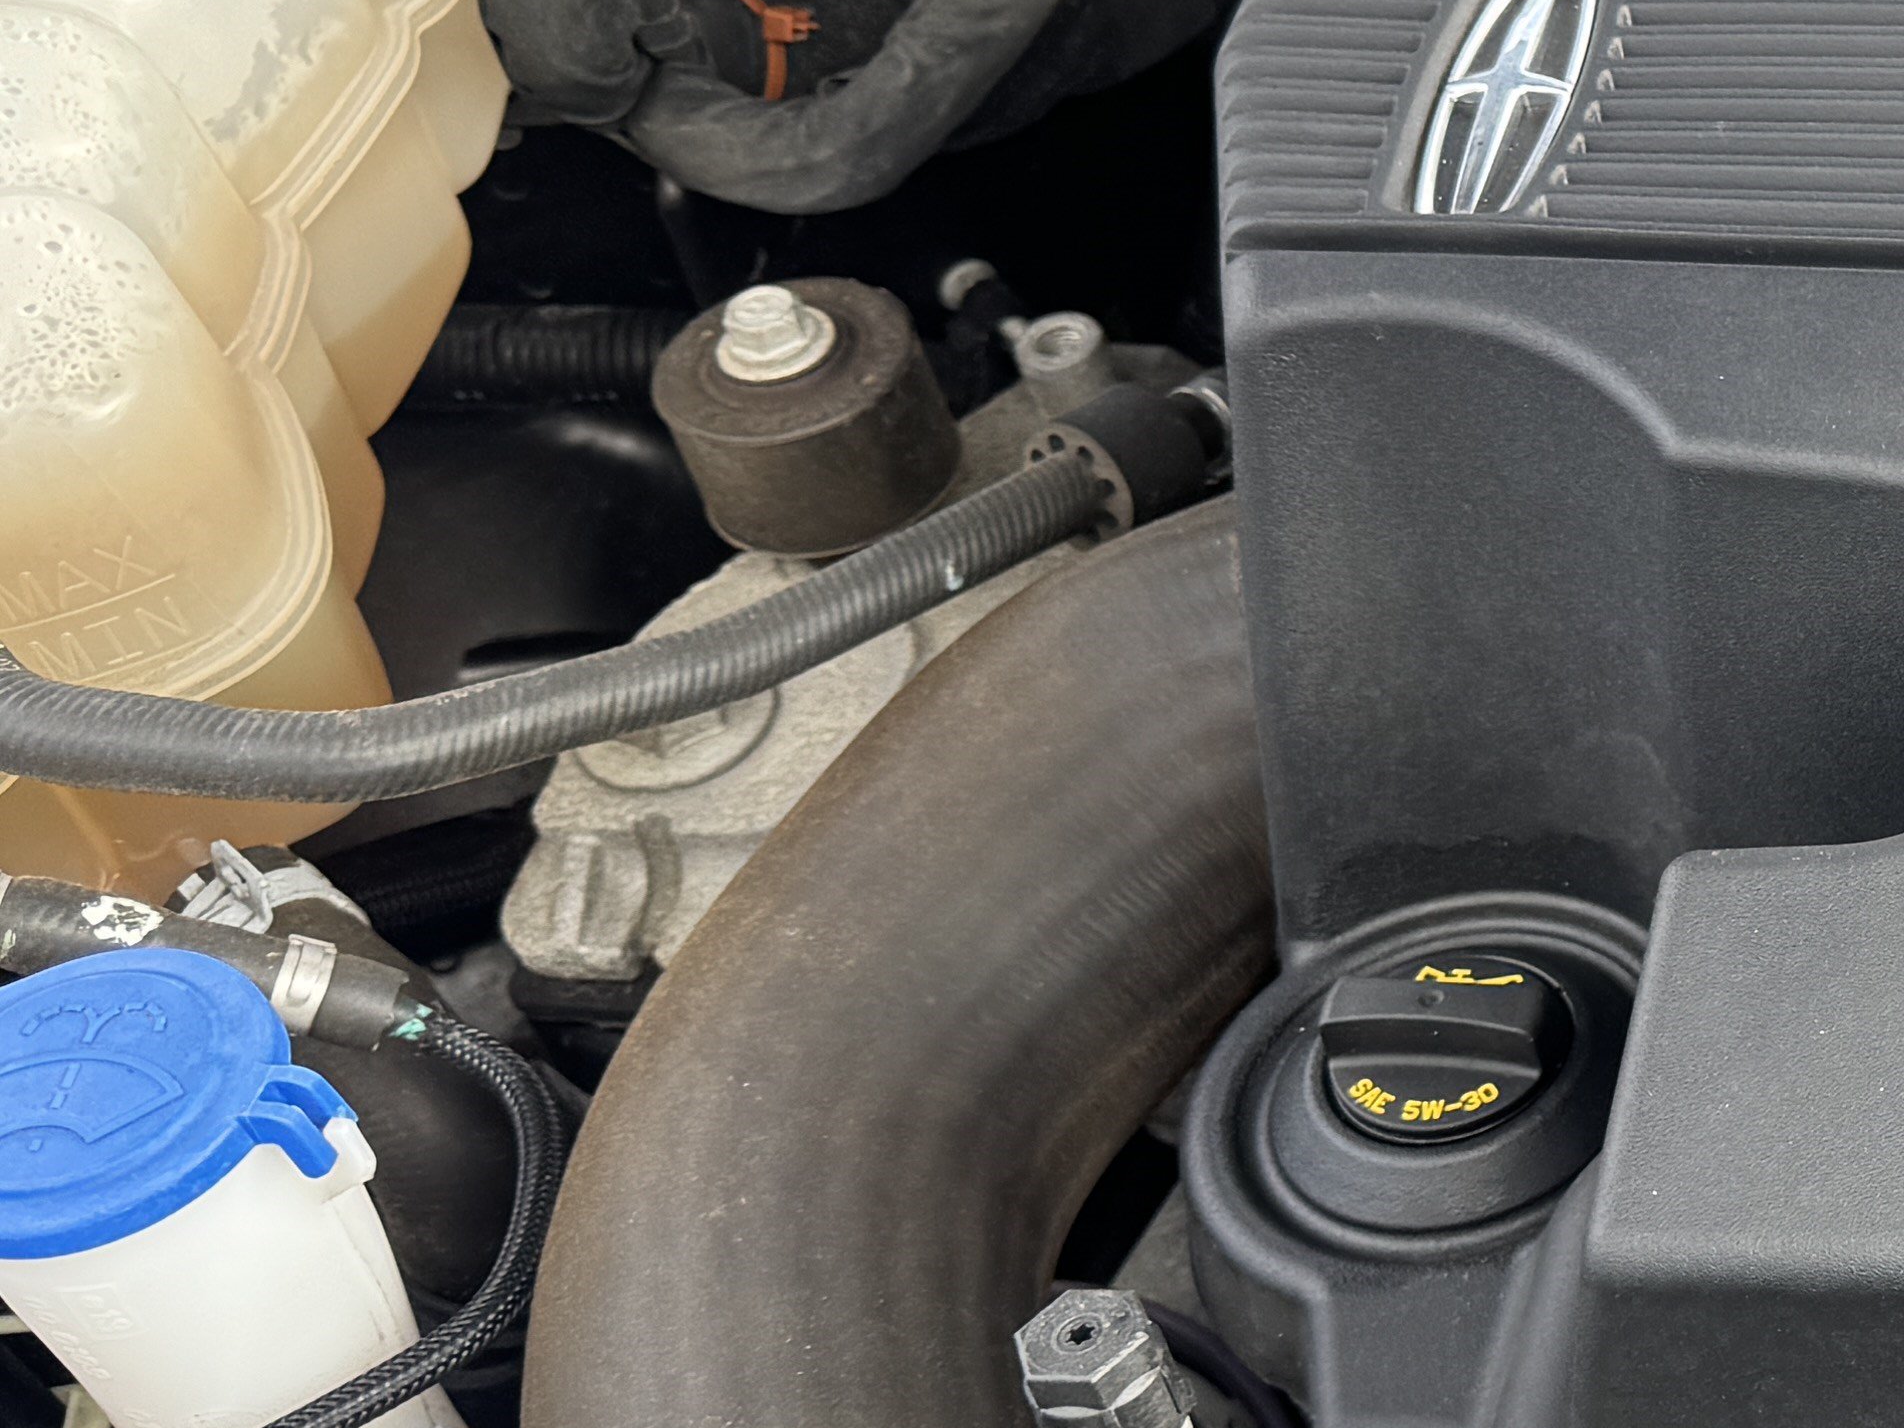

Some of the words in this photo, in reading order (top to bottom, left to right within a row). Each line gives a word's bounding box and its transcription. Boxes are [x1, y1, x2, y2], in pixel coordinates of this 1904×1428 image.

[0, 534, 157, 623] MAX
[27, 595, 190, 680] MIN
[1348, 1078, 1396, 1115] SAE
[1401, 1083, 1501, 1122] 5W-30
